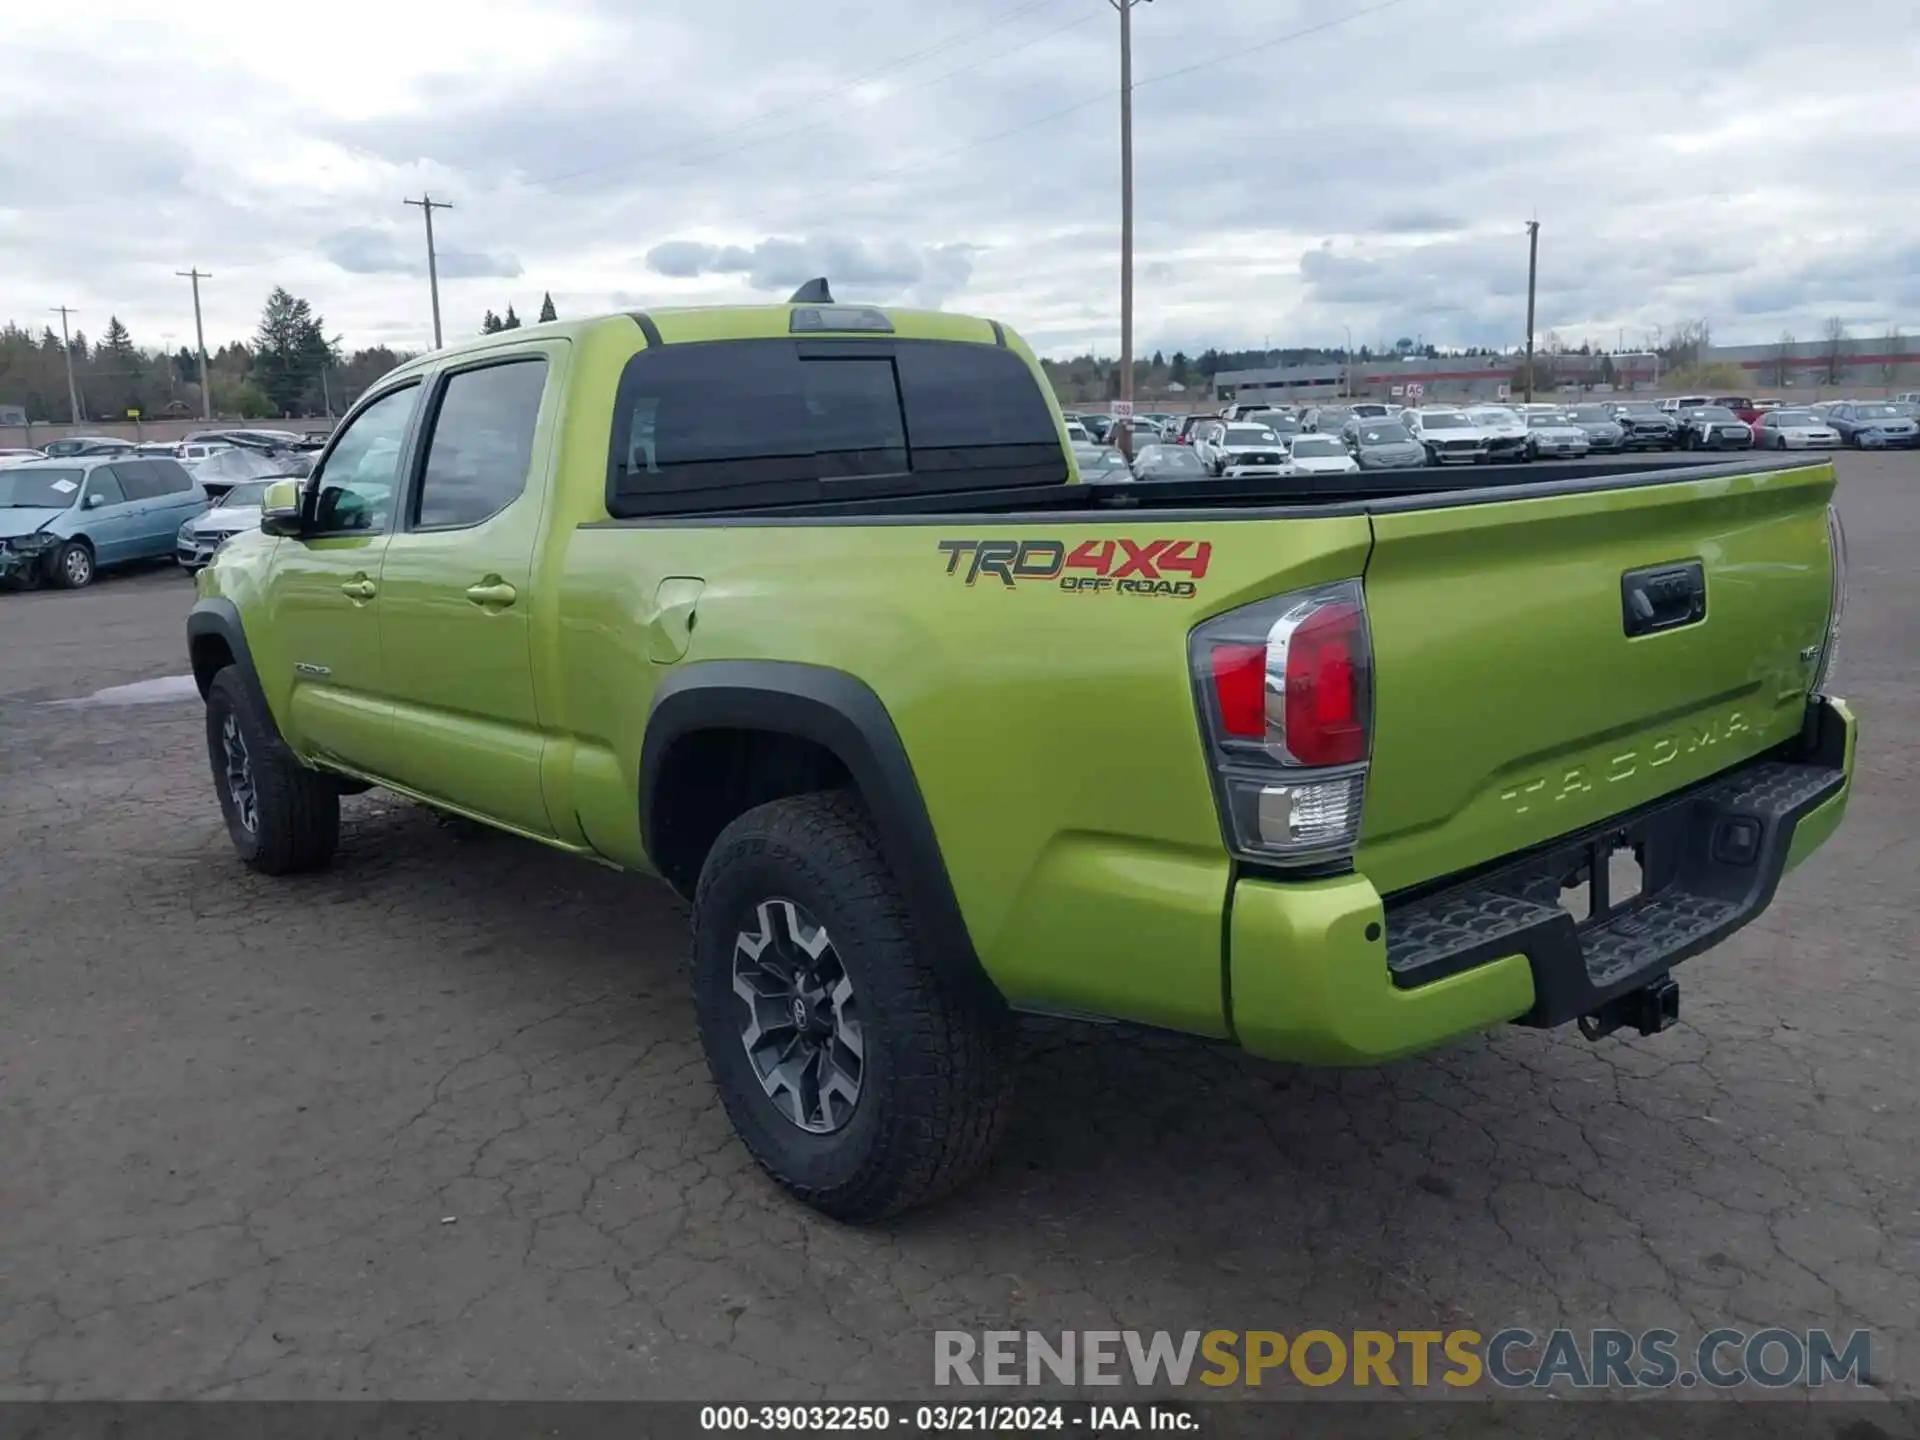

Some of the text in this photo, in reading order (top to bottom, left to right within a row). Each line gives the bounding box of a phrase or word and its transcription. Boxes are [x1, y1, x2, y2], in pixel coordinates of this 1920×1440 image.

[938, 540, 1066, 590] TRD
[1060, 576, 1196, 598] OFF ROAD
[1500, 712, 1749, 813] TACOMA
